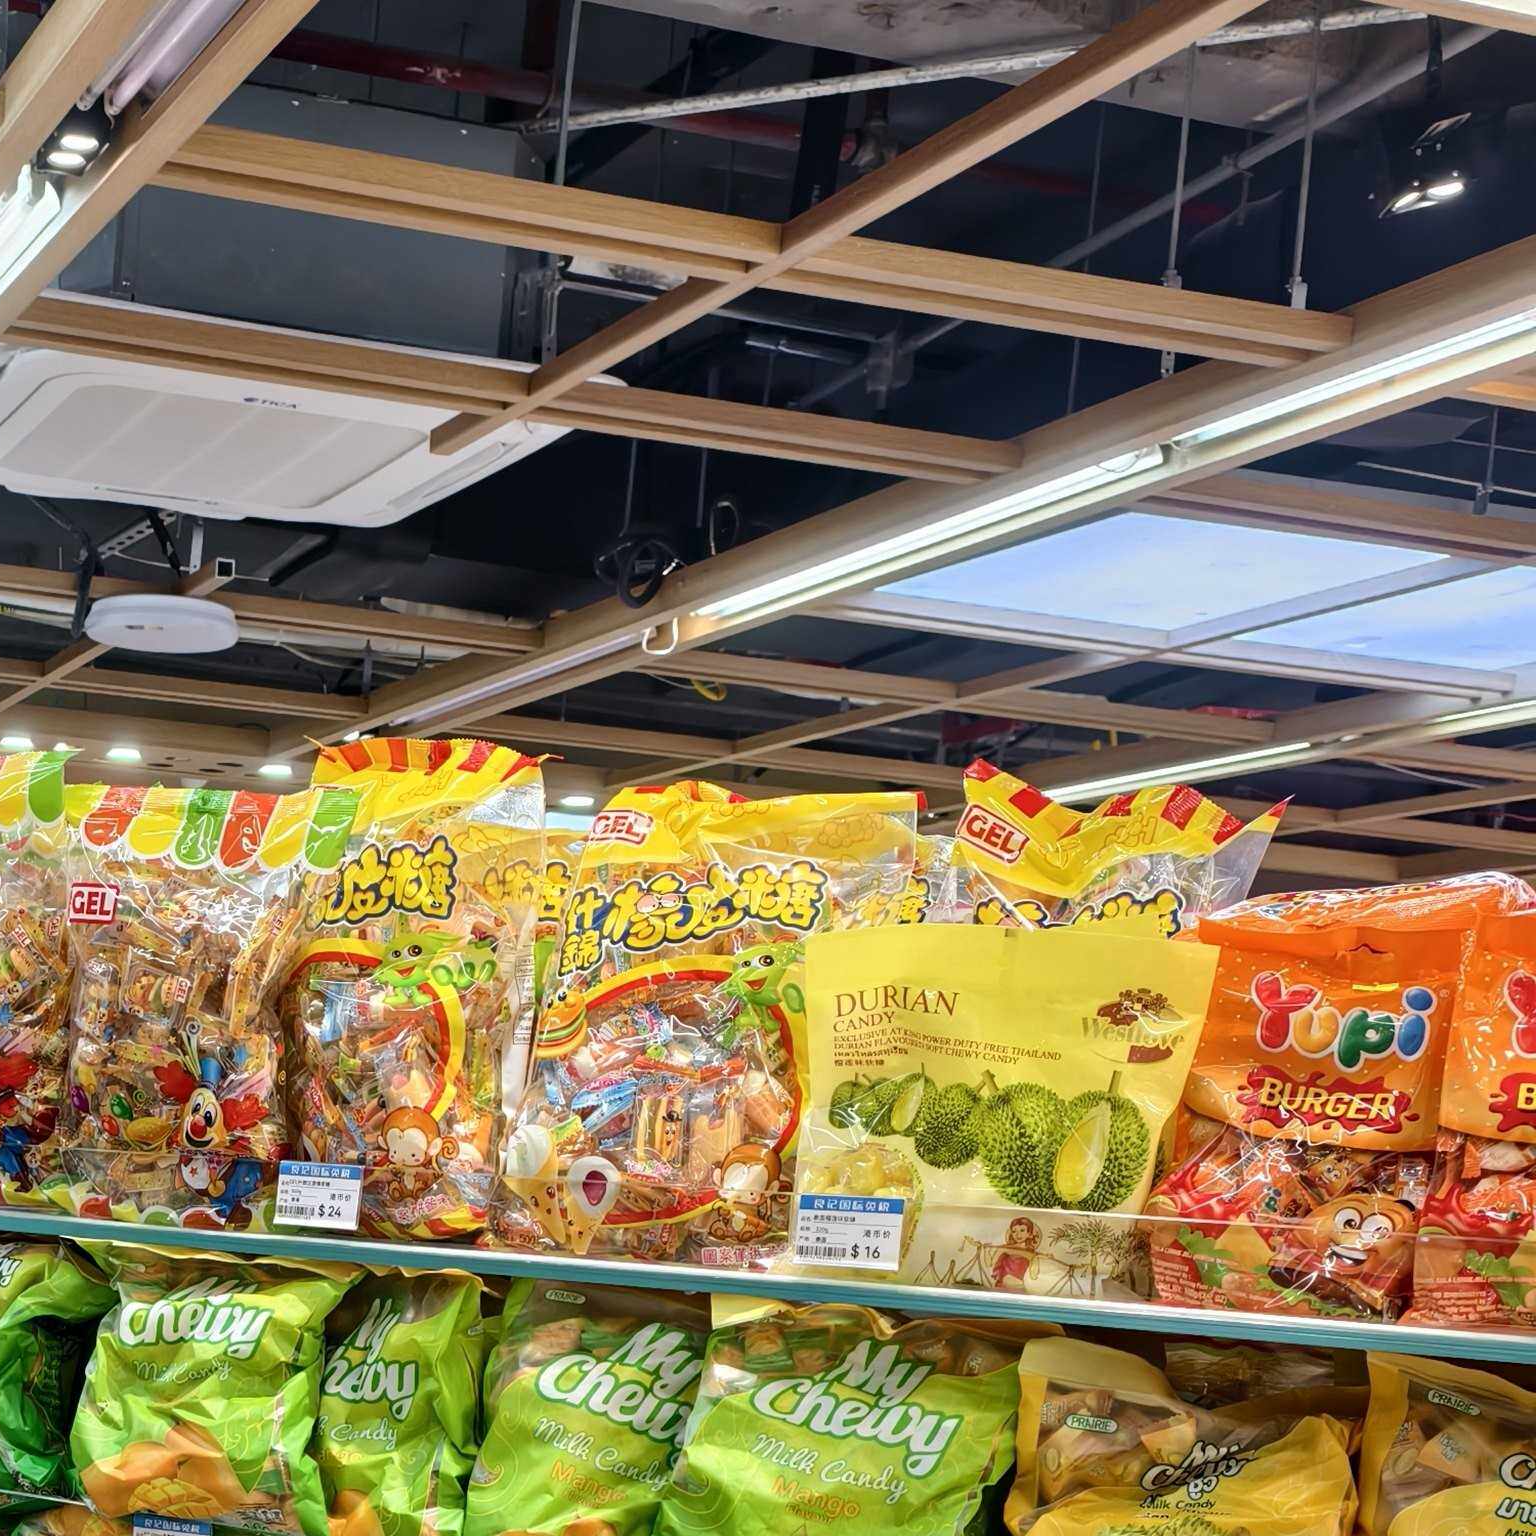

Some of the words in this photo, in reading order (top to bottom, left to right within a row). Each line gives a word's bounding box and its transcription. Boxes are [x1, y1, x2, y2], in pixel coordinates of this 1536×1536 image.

[595, 815, 647, 840] GEL
[966, 814, 1018, 854] GEL
[72, 892, 112, 916] GEL
[834, 985, 960, 1017] DURIAN
[833, 1011, 895, 1033] CANDY
[1252, 972, 1436, 1073] Yupi
[834, 1027, 889, 1043] EXCLUSIVE
[890, 1027, 903, 1036] AT
[922, 1033, 951, 1046] POWER
[953, 1039, 981, 1050] DUTY
[983, 1042, 1008, 1055] FREE
[1011, 1047, 1061, 1061] THAILAND
[834, 1040, 873, 1050] DURIAN
[925, 1043, 943, 1054] SOFT
[945, 1048, 981, 1059] CHEWY
[983, 1053, 1019, 1065] CANDY
[1260, 1078, 1400, 1121] BURGER
[318, 1203, 325, 1217] $
[329, 1206, 341, 1217] 24
[851, 1243, 859, 1259] $
[865, 1246, 880, 1259] 16
[119, 1294, 272, 1356] Chewy
[609, 1322, 703, 1397] My
[826, 1339, 936, 1405] My
[330, 1418, 398, 1451] Candy
[753, 1378, 961, 1476] Chewy
[1069, 1415, 1113, 1431] PRAIRIE
[535, 1416, 591, 1461] Milk
[595, 1444, 672, 1494] Candy
[753, 1433, 816, 1476] Milk
[822, 1459, 909, 1504] Candy
[770, 1475, 861, 1520] Mango
